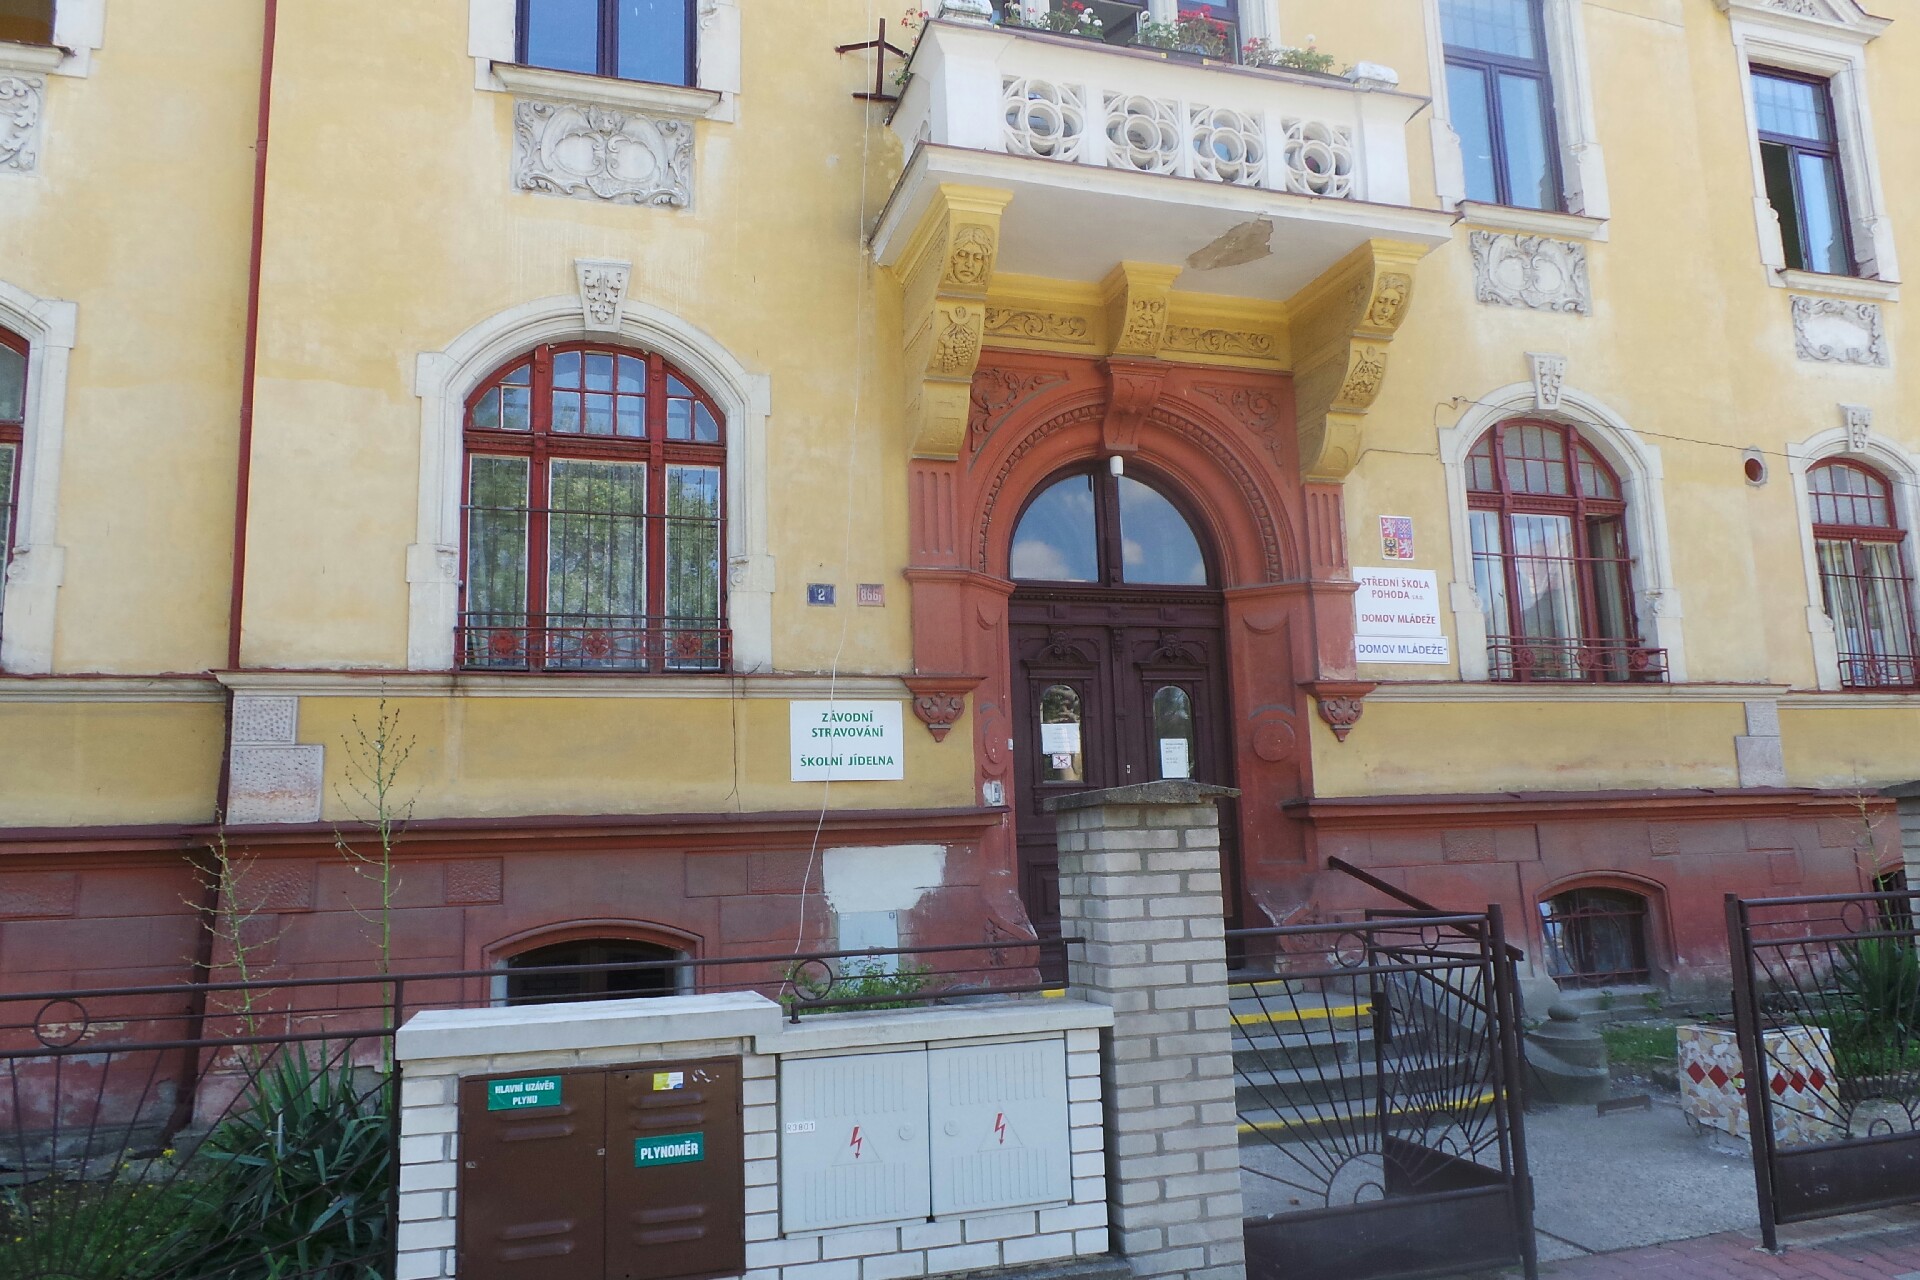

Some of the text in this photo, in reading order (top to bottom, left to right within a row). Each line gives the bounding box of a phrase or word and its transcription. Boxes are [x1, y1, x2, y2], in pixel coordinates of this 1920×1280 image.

[1361, 576, 1430, 589] STŘEDNÍ ŠKOLA
[818, 588, 825, 601] 2
[1371, 589, 1410, 600] POHODA
[1361, 613, 1436, 624] DOMOV MLÁDEŽE
[1358, 642, 1444, 655] DOMOV MLÁDEŽE
[821, 709, 874, 723] ZÁVODNÍ
[811, 725, 884, 738] STRAVOVÁNÍ
[800, 753, 895, 767] ŠKOLNÍ JÍDELNA
[494, 1079, 555, 1094] HLAVNÍ UZÁVĚR
[512, 1095, 538, 1106] PLYNU
[640, 1140, 699, 1161] PLYNOMĚR
